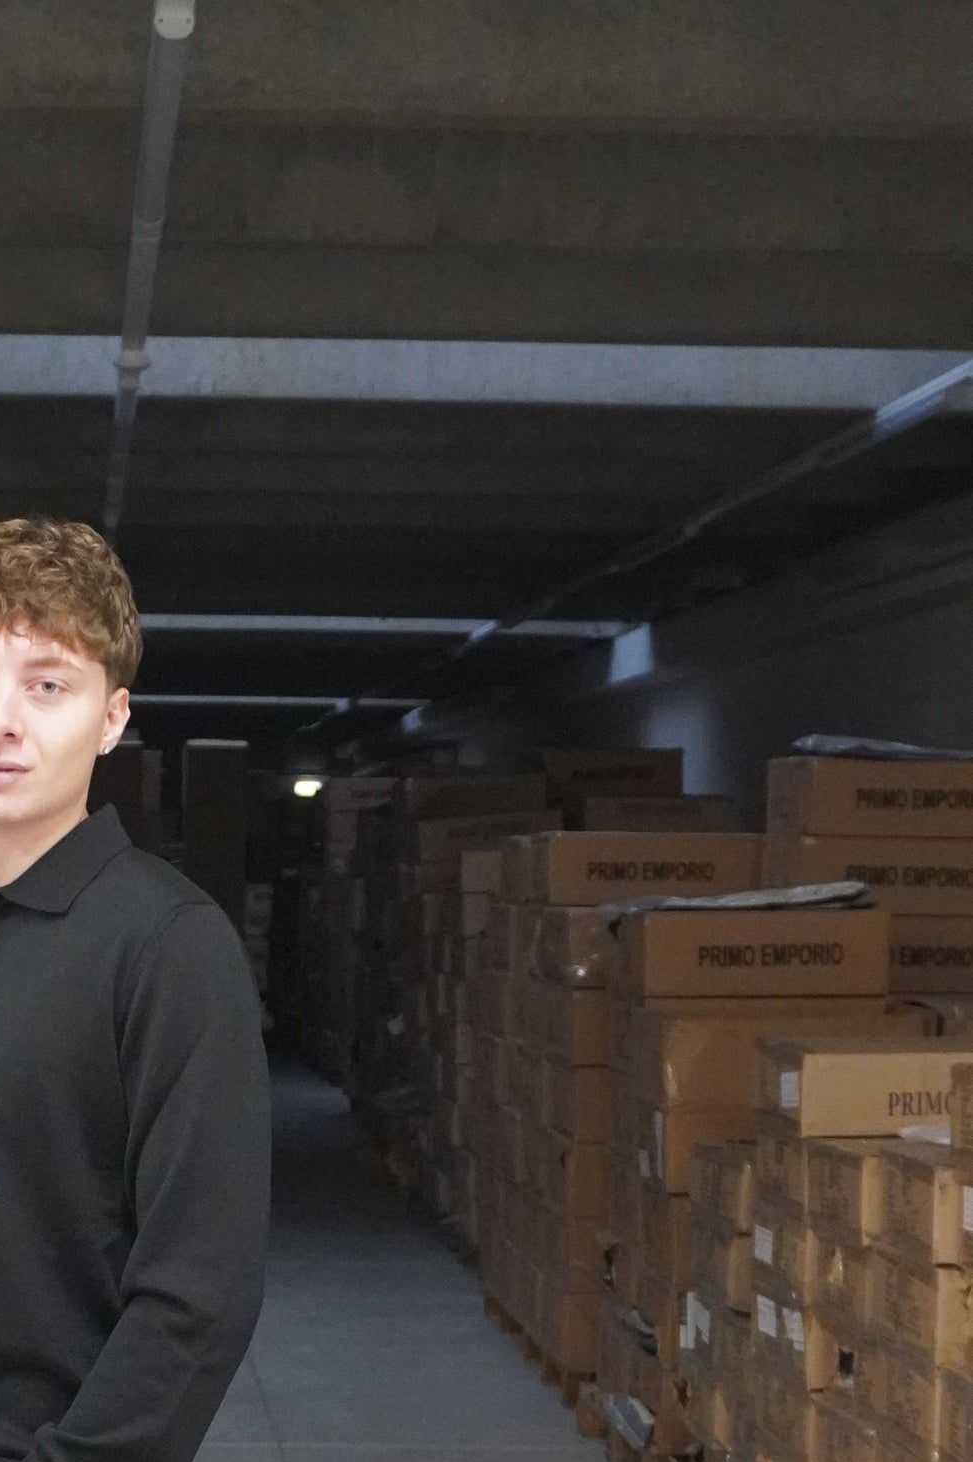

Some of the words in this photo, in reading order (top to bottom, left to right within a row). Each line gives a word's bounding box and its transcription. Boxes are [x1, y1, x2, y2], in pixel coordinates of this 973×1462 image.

[856, 788, 907, 808] PRIMO
[587, 861, 637, 881] PRIMO
[642, 862, 714, 881] EMPORIO
[698, 945, 755, 968] PRIMO
[761, 943, 844, 967] EMPORIO
